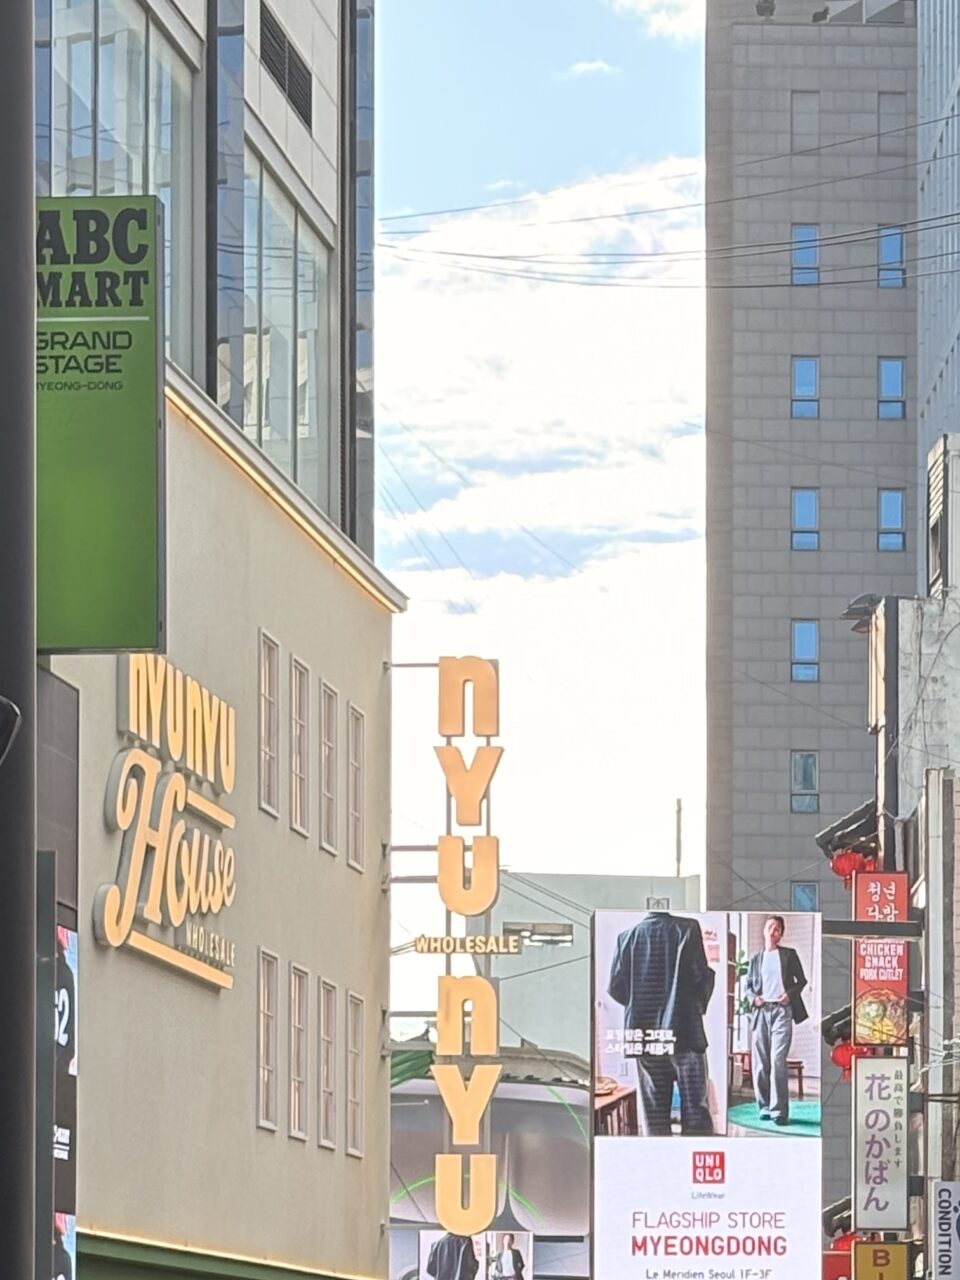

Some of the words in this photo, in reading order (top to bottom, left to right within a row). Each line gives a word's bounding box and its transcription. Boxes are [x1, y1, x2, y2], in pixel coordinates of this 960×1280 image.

[36, 207, 149, 266] ABC
[36, 270, 149, 308] MART
[36, 330, 132, 351] GRAND
[36, 354, 122, 374] STAGE
[415, 935, 519, 953] WHOLESALE
[860, 943, 904, 956] CHICKEN
[864, 956, 899, 968] SNACK
[863, 1073, 891, 1212] 花のかばん
[631, 1211, 720, 1229] FLAGSHIP
[727, 1211, 786, 1229] STORE
[938, 1188, 952, 1276] CONDITION
[631, 1235, 787, 1257] MYEONGDONG
[646, 1268, 659, 1280] Le
[708, 1268, 735, 1280] Seoul
